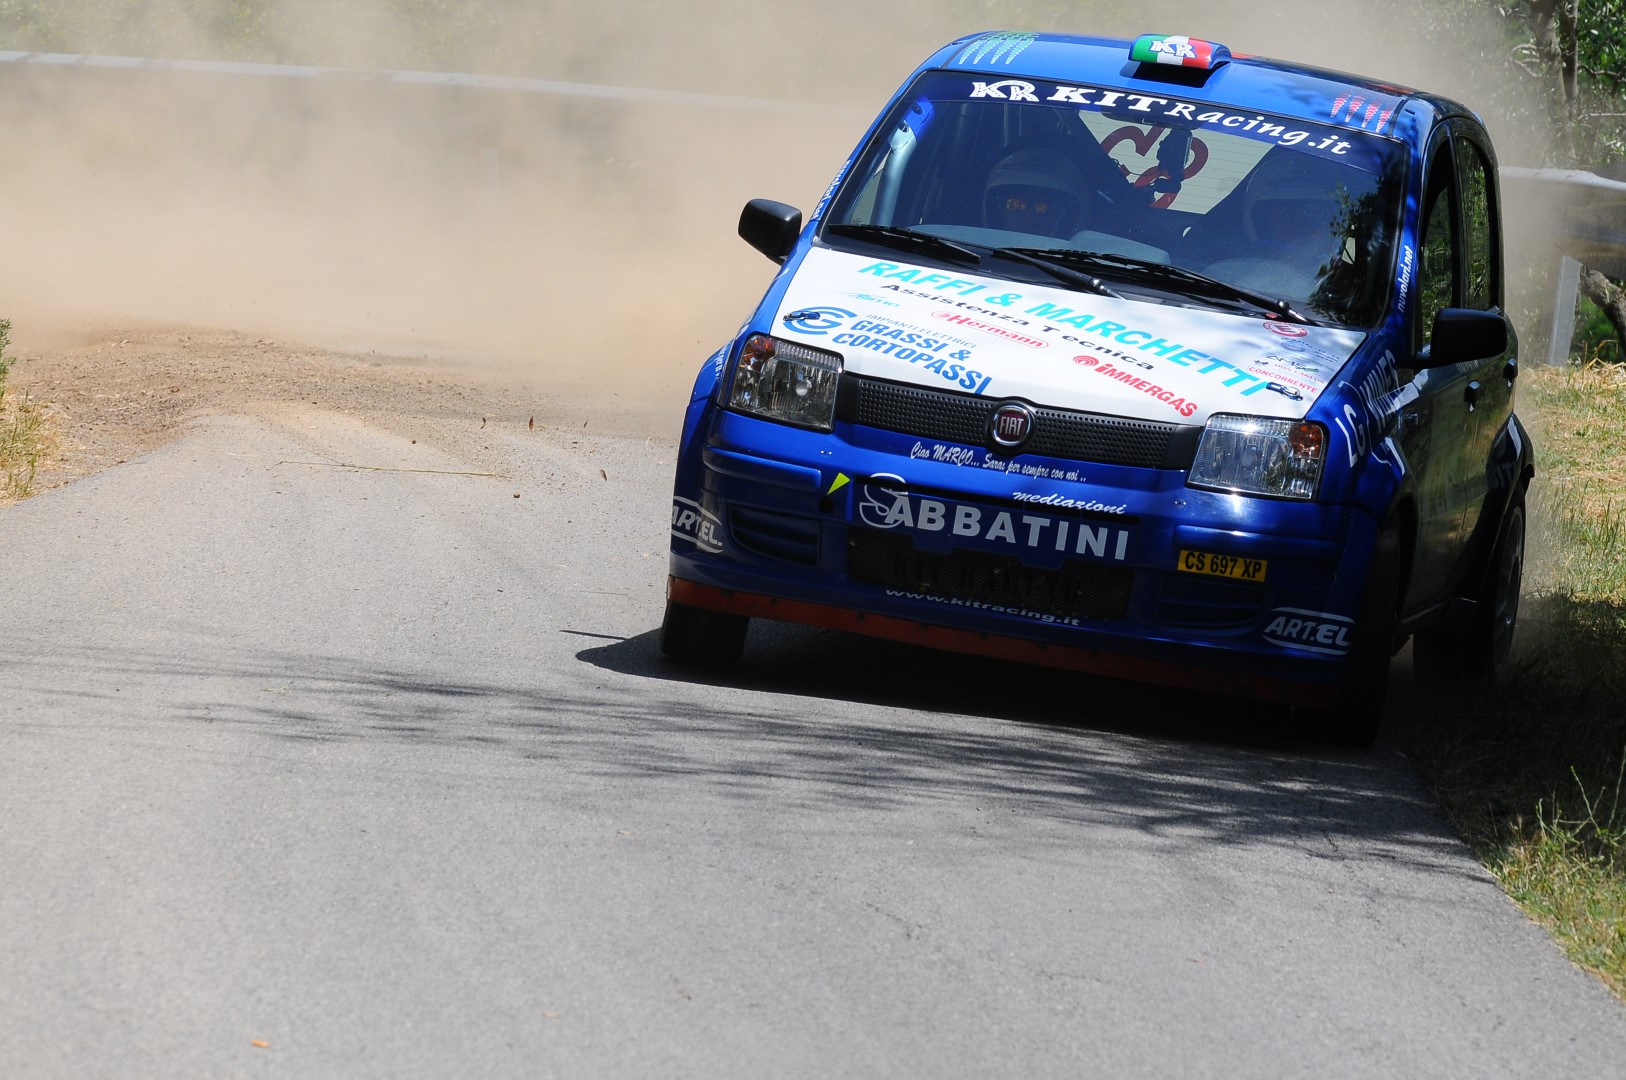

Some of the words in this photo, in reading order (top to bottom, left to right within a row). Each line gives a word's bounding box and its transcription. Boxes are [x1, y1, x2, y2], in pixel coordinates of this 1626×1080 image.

[1149, 40, 1197, 59] KR
[969, 79, 1040, 103] KR
[1397, 244, 1413, 313] nuvolari.net
[850, 320, 949, 353] GRASSI
[948, 349, 972, 362] &
[857, 262, 988, 296] RAFFI
[984, 293, 1023, 307] &
[1023, 302, 1267, 397] MARCHETTI
[866, 314, 919, 332] IMPIANTI
[919, 327, 977, 349] ELETTRICI
[880, 284, 1030, 326] Assistenza
[1041, 325, 1155, 371] Tecnica
[946, 314, 1043, 348] Hermann
[832, 333, 993, 396] CORTOPASSI
[1248, 366, 1318, 393] CONCORRENTE
[1000, 416, 1025, 436] FIAT
[910, 441, 930, 459] Ciao
[932, 444, 980, 467] MARCO...
[1005, 460, 1021, 475] per
[1021, 465, 1050, 480] sempre
[1050, 468, 1065, 479] con
[1012, 491, 1128, 516] mediazioni
[1184, 551, 1206, 572] CS
[1209, 555, 1240, 577] 697
[1240, 559, 1263, 579] XP
[885, 589, 1082, 627] www.kitracing.it
